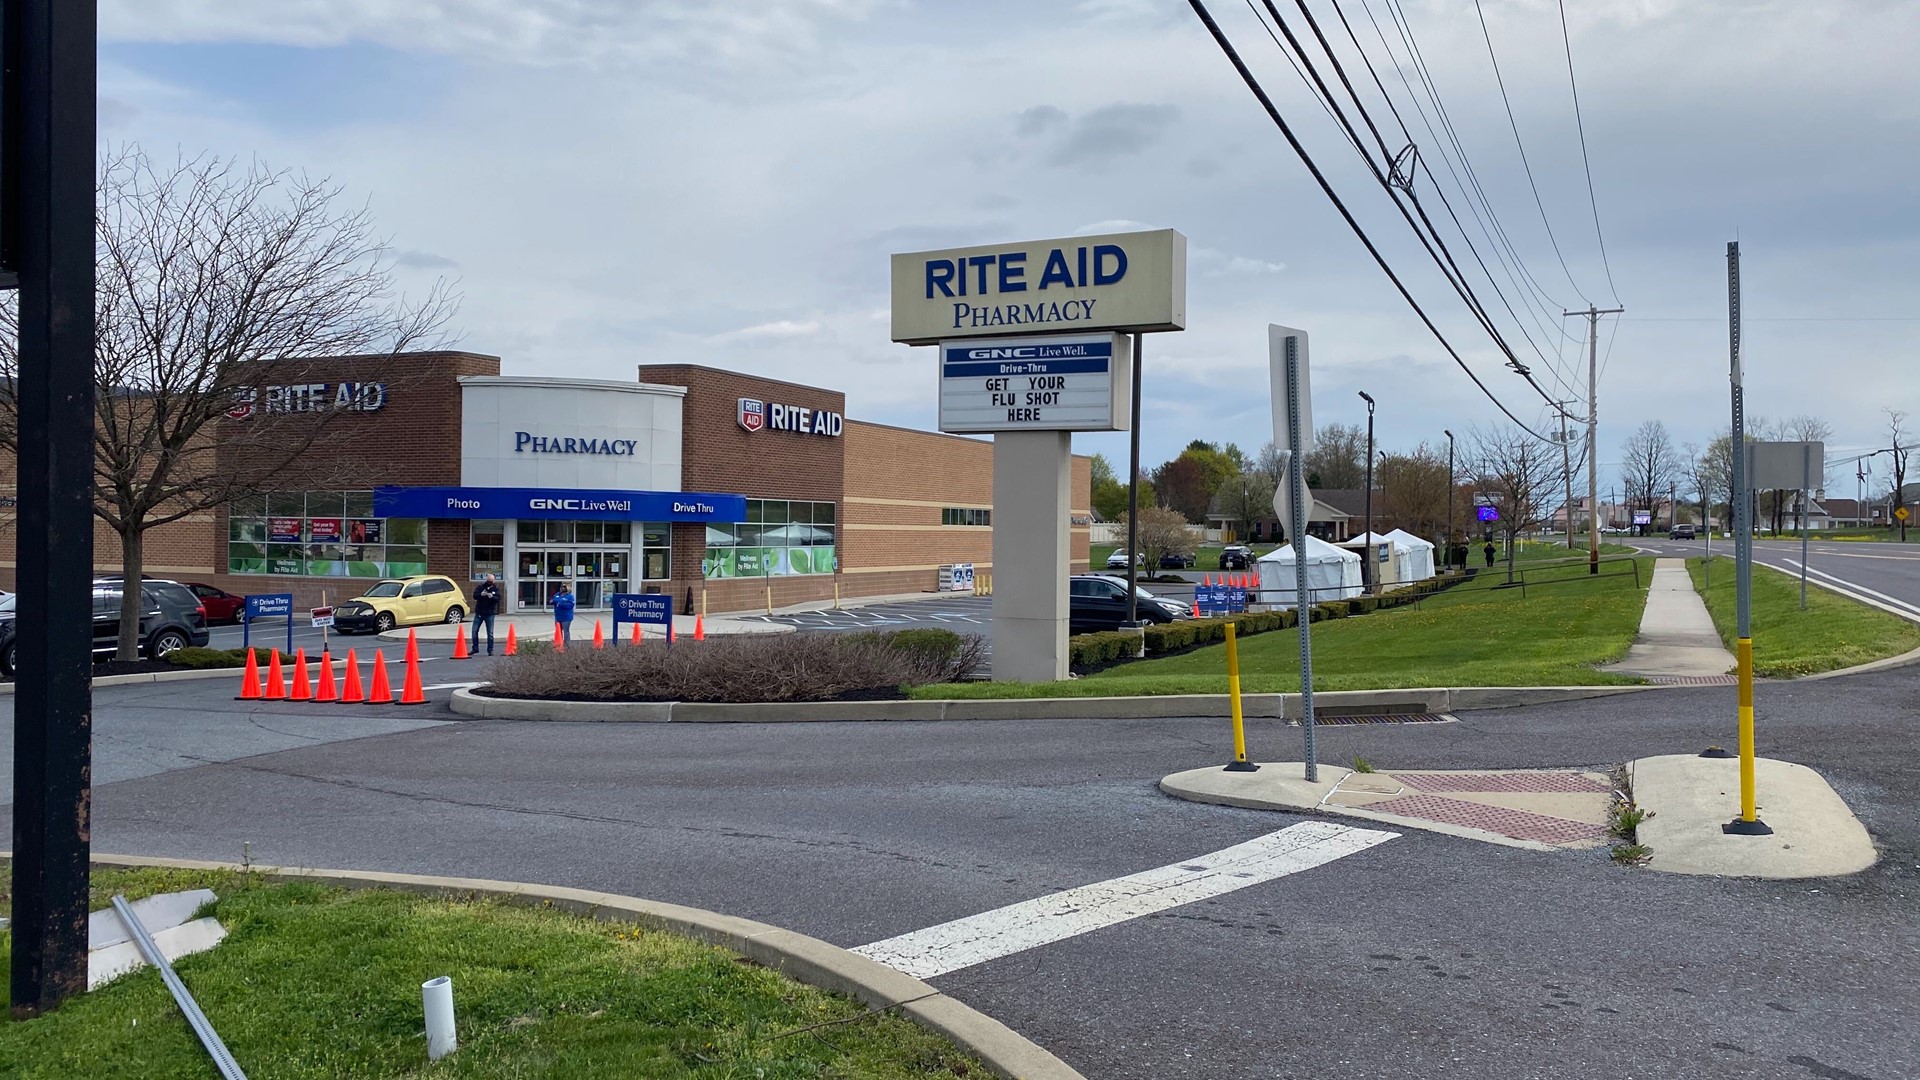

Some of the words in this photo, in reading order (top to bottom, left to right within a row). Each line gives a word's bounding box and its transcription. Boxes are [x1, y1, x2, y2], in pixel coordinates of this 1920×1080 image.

[925, 251, 1027, 299] RITE
[1038, 244, 1128, 290] AID
[952, 299, 1097, 329] PHARMACY
[968, 347, 1036, 359] GNC
[1039, 346, 1060, 357] Live
[1062, 345, 1087, 356] Well.
[1000, 362, 1047, 374] Drive-Thru
[985, 378, 1010, 392] GET
[1029, 376, 1065, 390] YOUR
[265, 383, 325, 414] RITE
[333, 381, 384, 412] AID
[992, 393, 1016, 406] FLU
[1026, 392, 1060, 406] SHOT
[745, 401, 761, 412] RITE
[746, 414, 760, 426] AID
[771, 403, 810, 433] RITE
[814, 410, 843, 437] AID
[1007, 408, 1041, 422] HERE
[514, 431, 638, 456] PHARMACY
[447, 498, 480, 509] Photo
[529, 499, 579, 510] GNC
[581, 500, 605, 511] Live
[606, 501, 631, 512] Well
[673, 502, 696, 513] Drive
[697, 503, 714, 513] Thru
[259, 598, 275, 606] Drive
[628, 599, 647, 609] Drive
[648, 600, 665, 609] Thru
[259, 605, 288, 613] Pharmacy
[628, 609, 664, 620] Pharmacy
